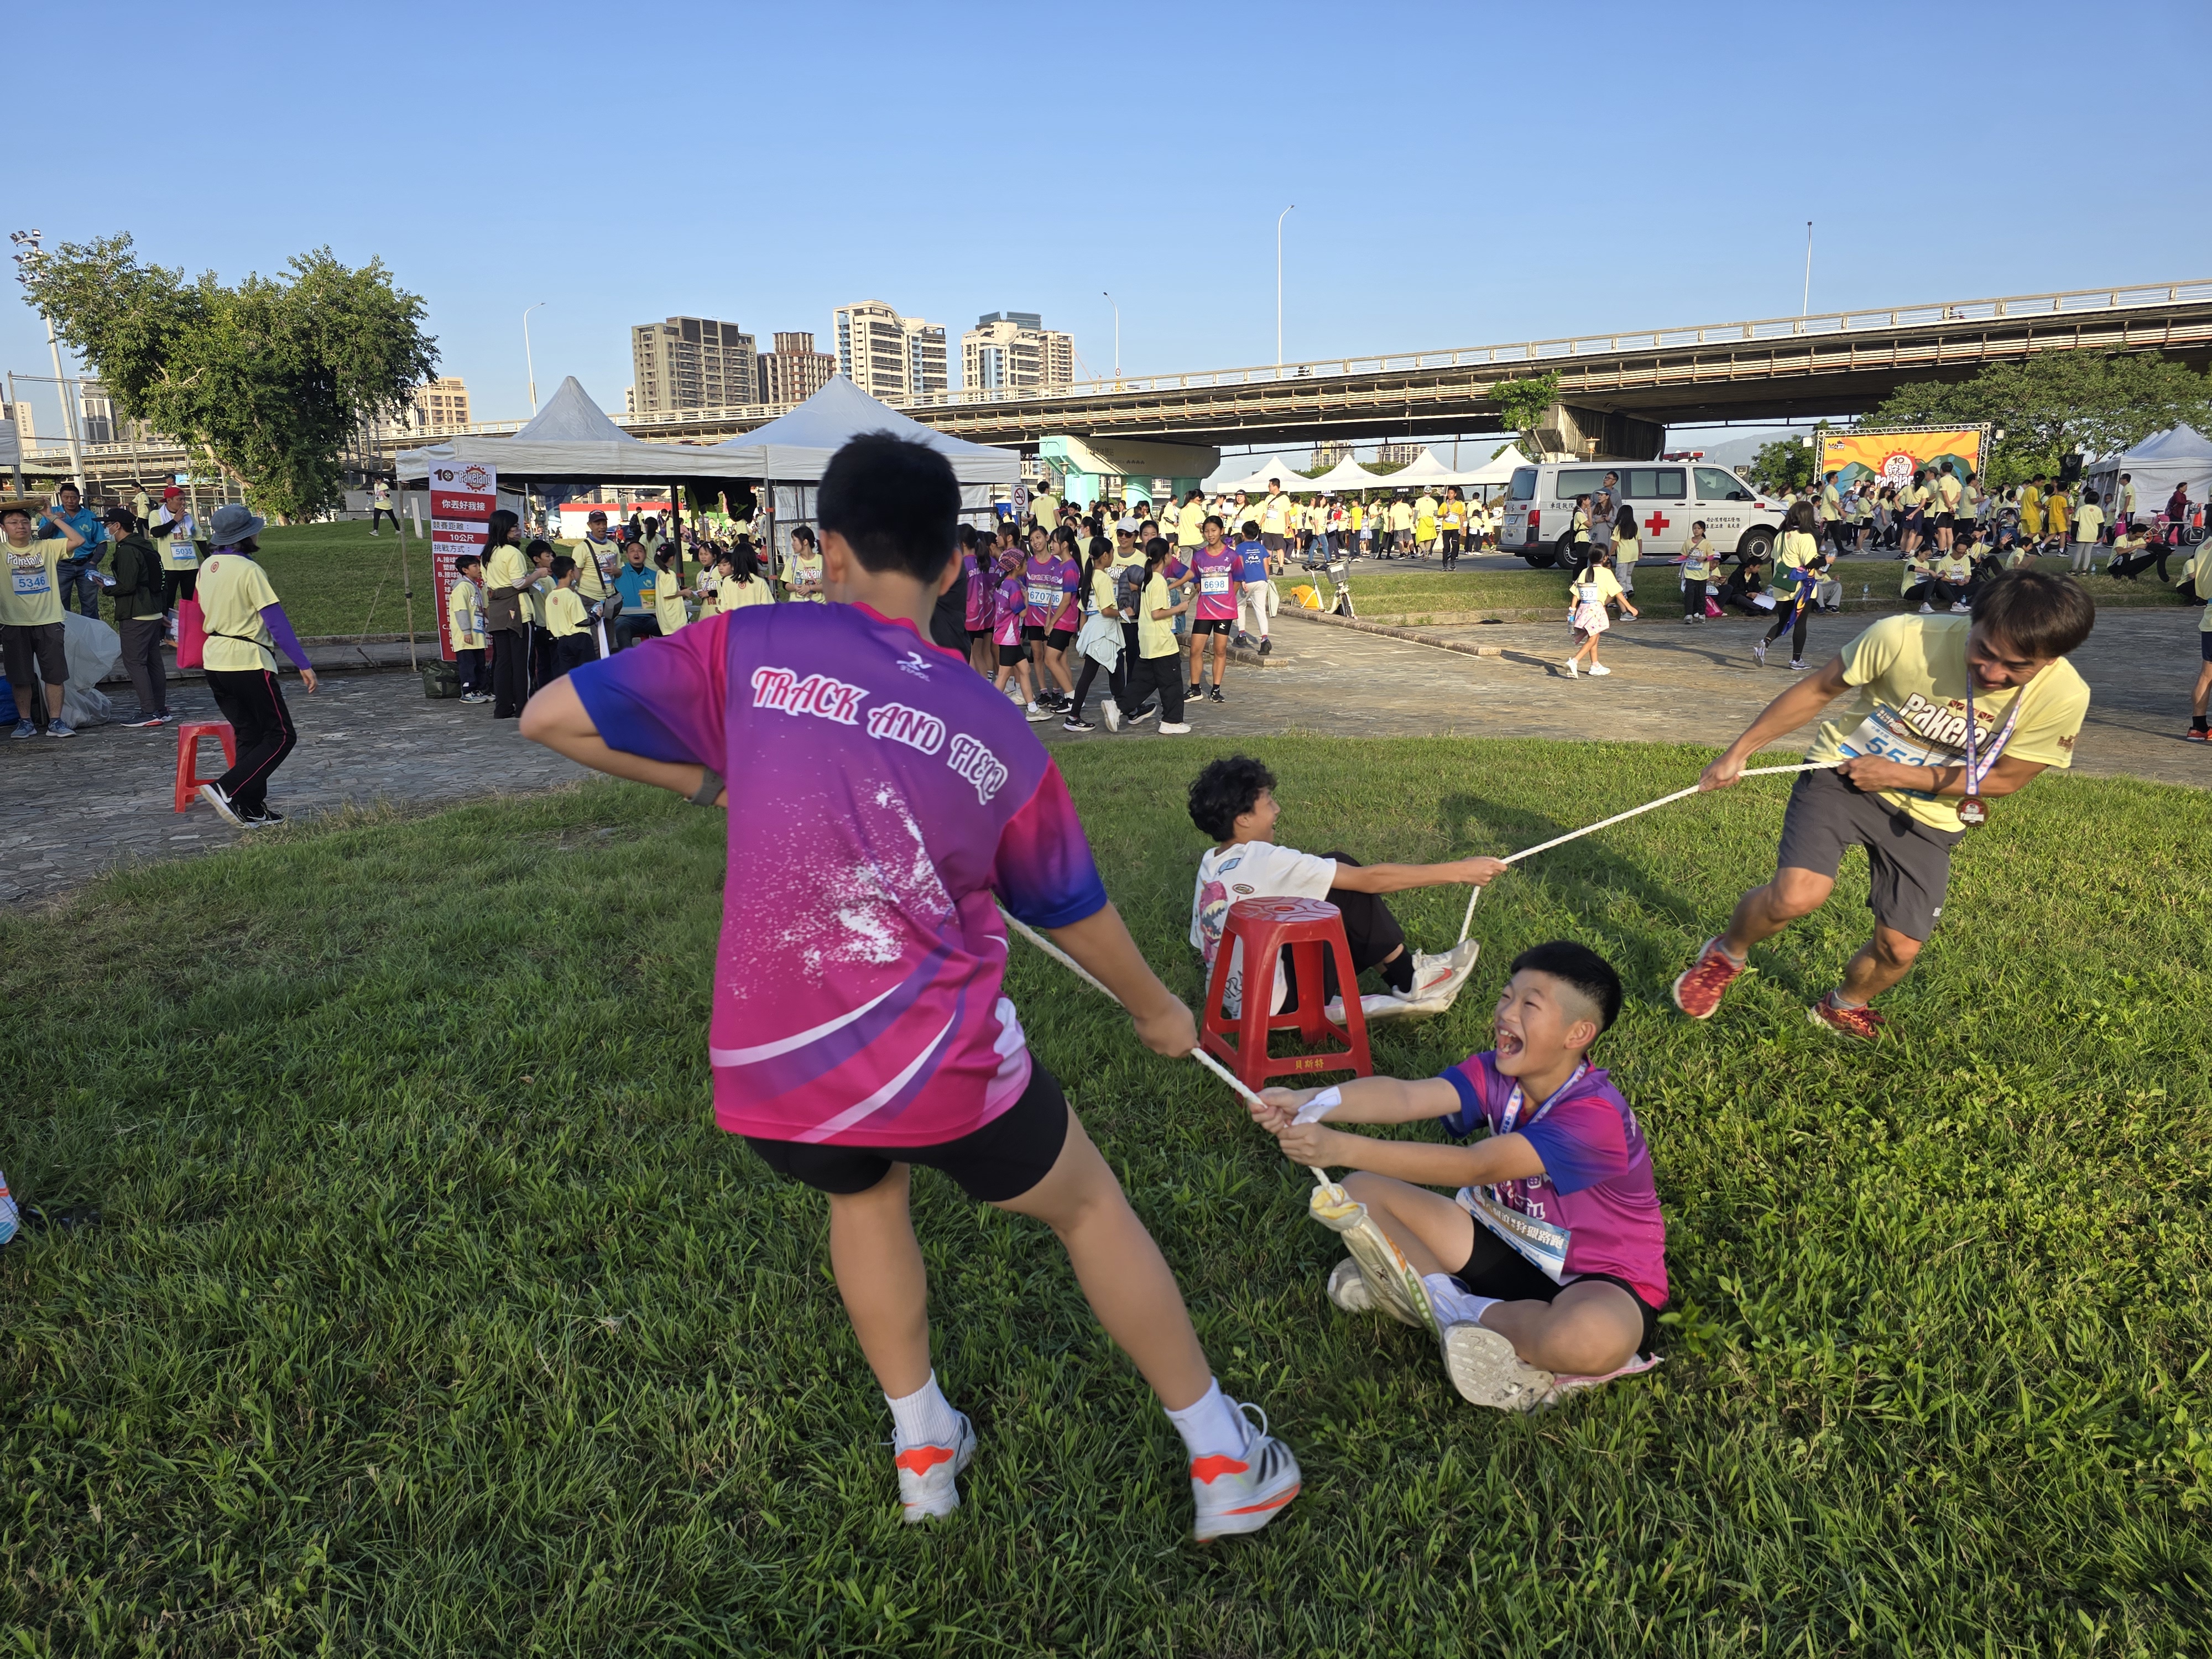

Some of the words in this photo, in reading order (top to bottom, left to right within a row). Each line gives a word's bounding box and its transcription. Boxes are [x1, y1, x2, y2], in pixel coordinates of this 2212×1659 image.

[458, 470, 492, 486] Pakelang
[442, 499, 485, 511] 你丟好我接
[18, 576, 45, 587] 5346
[1204, 580, 1224, 588] 6698
[1030, 592, 1051, 601] 6707
[751, 666, 870, 725] TRACK
[867, 702, 946, 755] AND
[1897, 692, 2001, 753] Pakela
[1865, 736, 1944, 766] 552
[1295, 1058, 1324, 1070] 貝斯特
